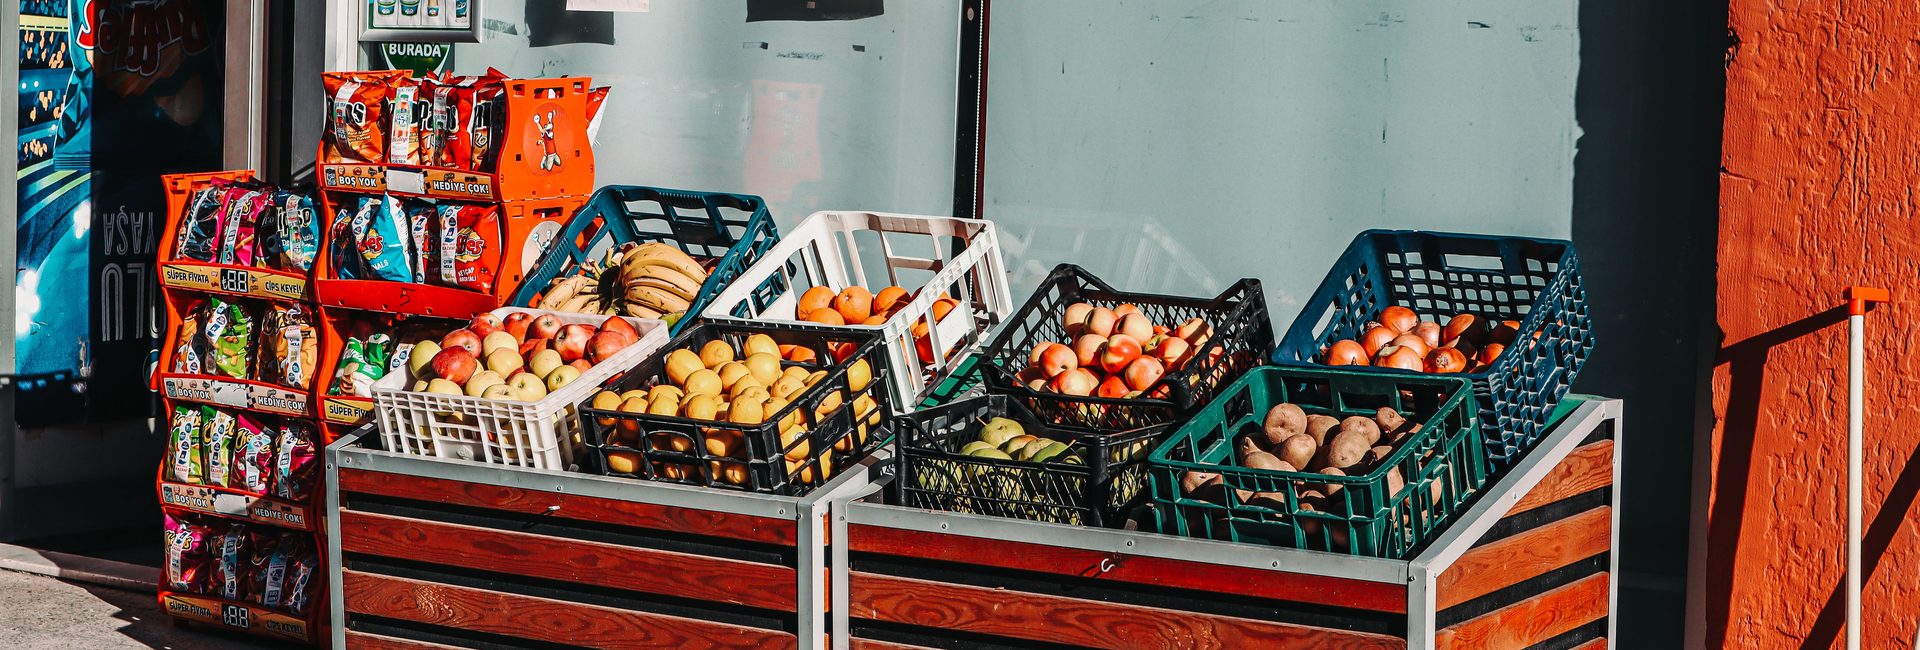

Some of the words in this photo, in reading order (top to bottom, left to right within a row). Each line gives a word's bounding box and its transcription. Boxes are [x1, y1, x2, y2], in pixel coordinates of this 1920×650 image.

[389, 43, 441, 58] BURADA
[338, 175, 356, 188] BOŞ
[358, 177, 377, 187] YOK
[433, 179, 465, 192] HEDİYE
[467, 183, 489, 195] ÇOK!
[167, 269, 187, 281] SÜPER
[188, 271, 210, 284] FİYATA
[265, 281, 280, 291] CİPS
[178, 388, 193, 400] BOŞ
[194, 390, 211, 400] YOK
[258, 395, 286, 408] HEDİYE
[287, 399, 306, 411] ÇOK!
[329, 404, 353, 417] SÜPER
[175, 493, 190, 506] BOŞ
[191, 496, 208, 508] YOK
[284, 512, 303, 524] ÇOK!
[169, 600, 189, 613] SÜPER
